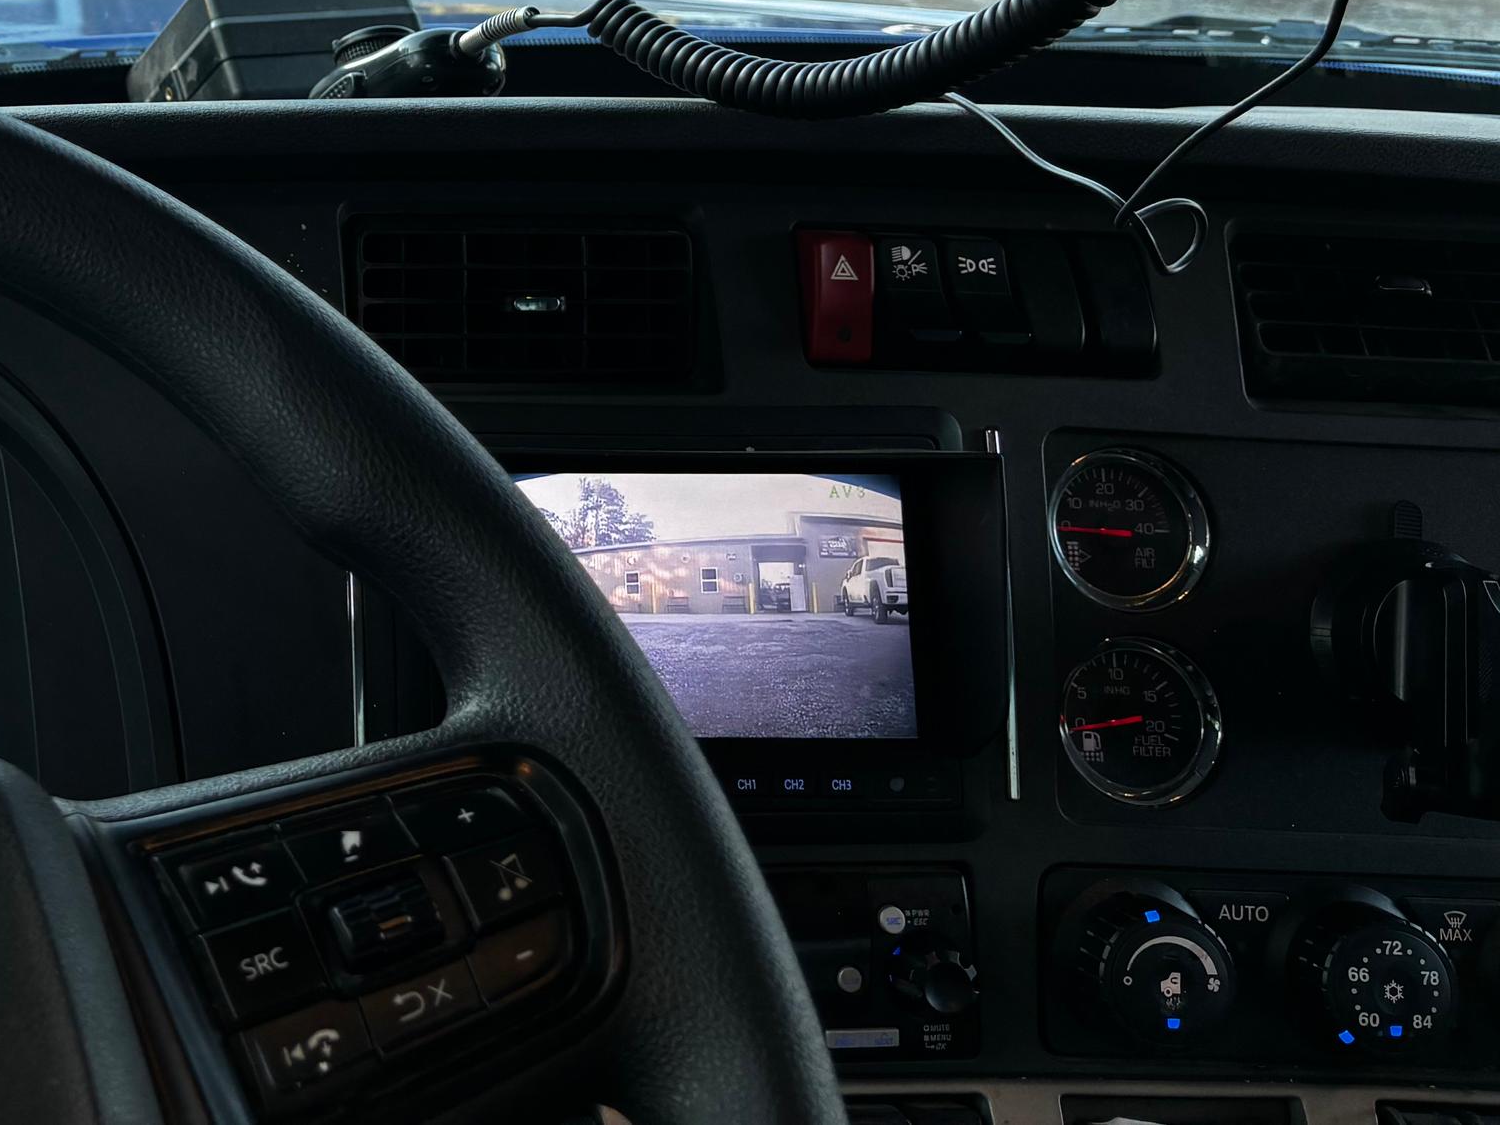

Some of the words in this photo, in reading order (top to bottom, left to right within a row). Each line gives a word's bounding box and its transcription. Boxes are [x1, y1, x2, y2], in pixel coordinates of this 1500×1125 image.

[1095, 483, 1115, 495] 20
[1066, 497, 1083, 509] 10
[1125, 499, 1145, 512] 30
[1135, 523, 1155, 535] 40
[1135, 547, 1156, 558] AIR
[1135, 558, 1156, 569] FILT
[1108, 667, 1124, 681] 10
[1077, 686, 1087, 700] 5
[1143, 690, 1157, 703] 15
[1146, 720, 1166, 733] 20
[1135, 735, 1165, 746] FUEL
[1132, 746, 1172, 757] FILTER
[738, 779, 756, 790] CH1
[784, 779, 805, 790] CH2
[831, 779, 852, 791] CH3
[1219, 904, 1269, 922] AUTO
[1440, 928, 1472, 942] MAX
[1382, 940, 1403, 956] 72
[241, 947, 289, 980] SRC
[1348, 967, 1370, 983] 66
[1421, 971, 1440, 986] 78
[1358, 1012, 1380, 1027] 60
[1412, 1015, 1433, 1029] 84
